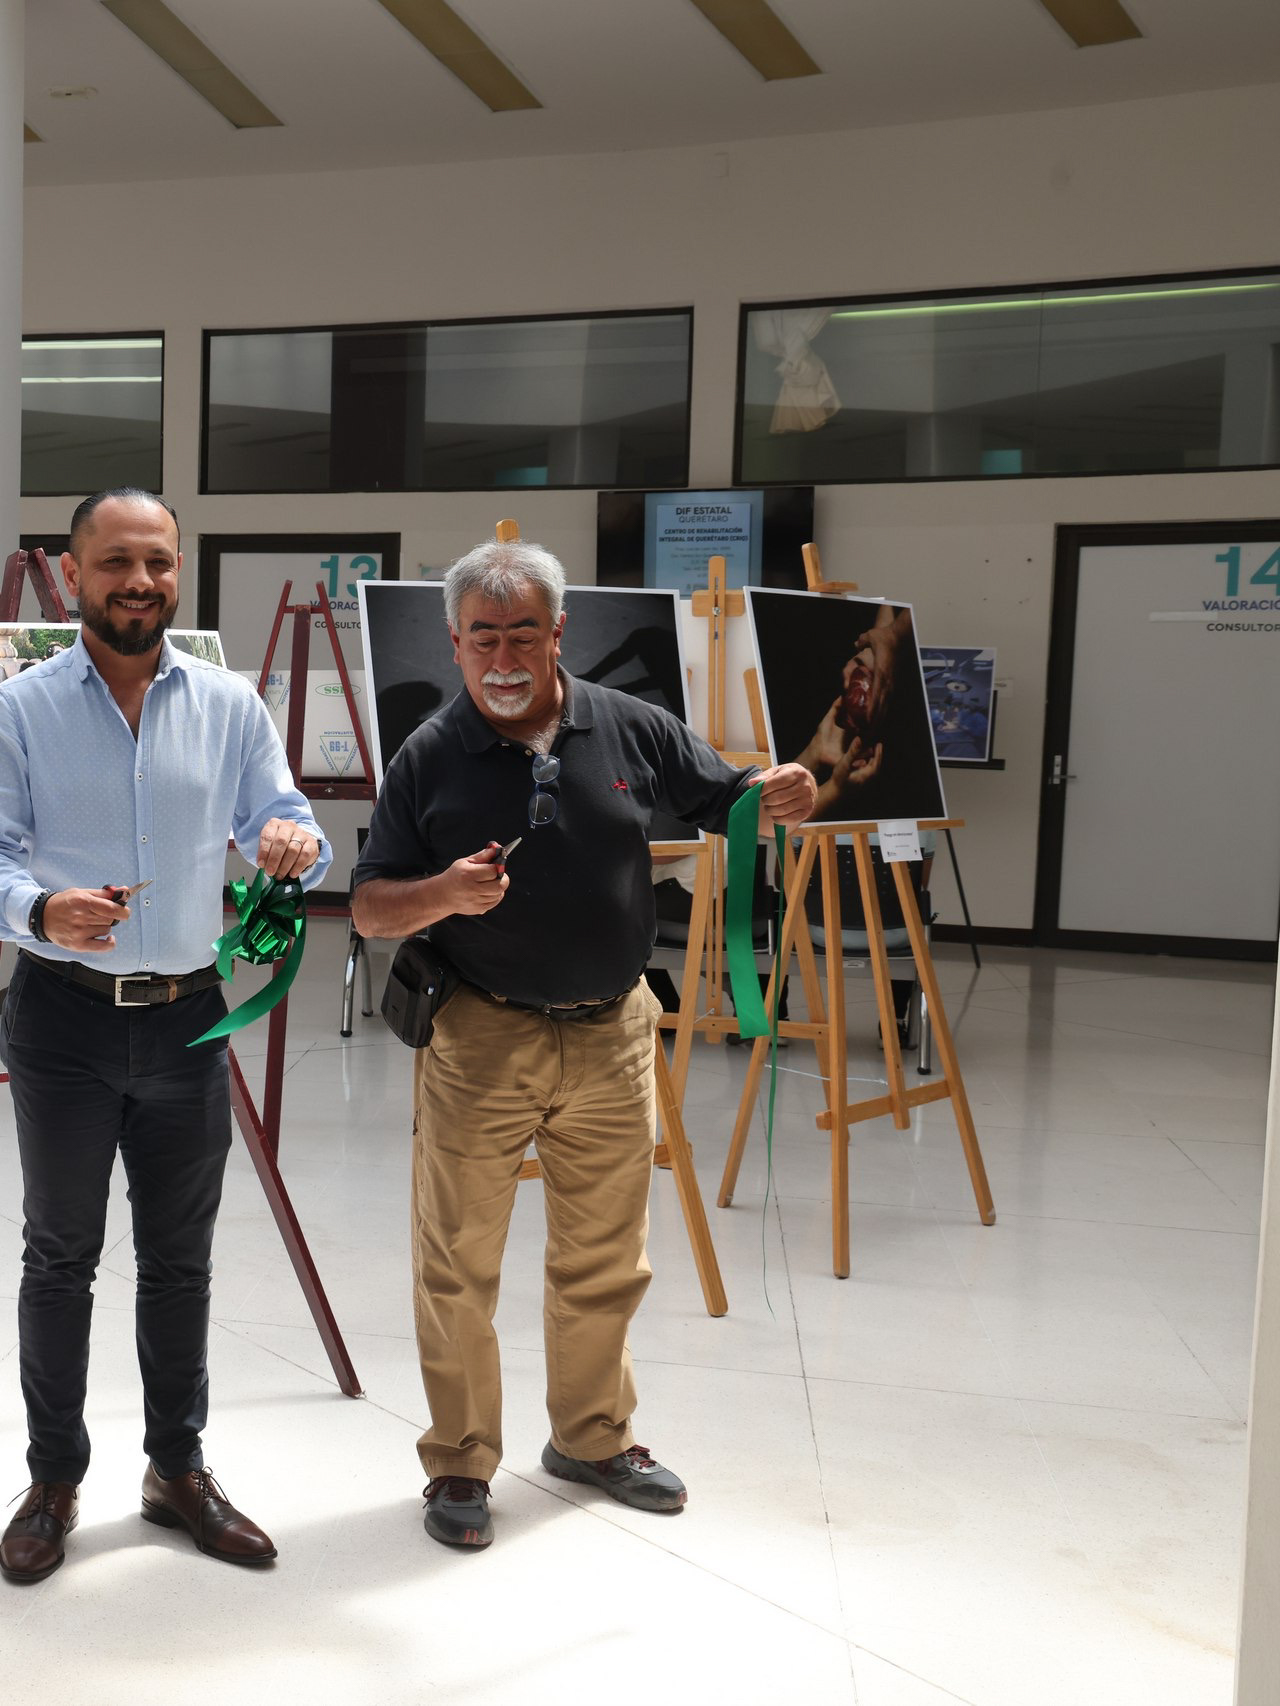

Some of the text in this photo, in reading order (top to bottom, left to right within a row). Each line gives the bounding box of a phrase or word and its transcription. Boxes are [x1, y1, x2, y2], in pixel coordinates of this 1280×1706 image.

[676, 506, 732, 515] DIF ESTATAL
[320, 554, 378, 598] 13
[1215, 545, 1280, 597] 14
[310, 600, 360, 610] VORAC
